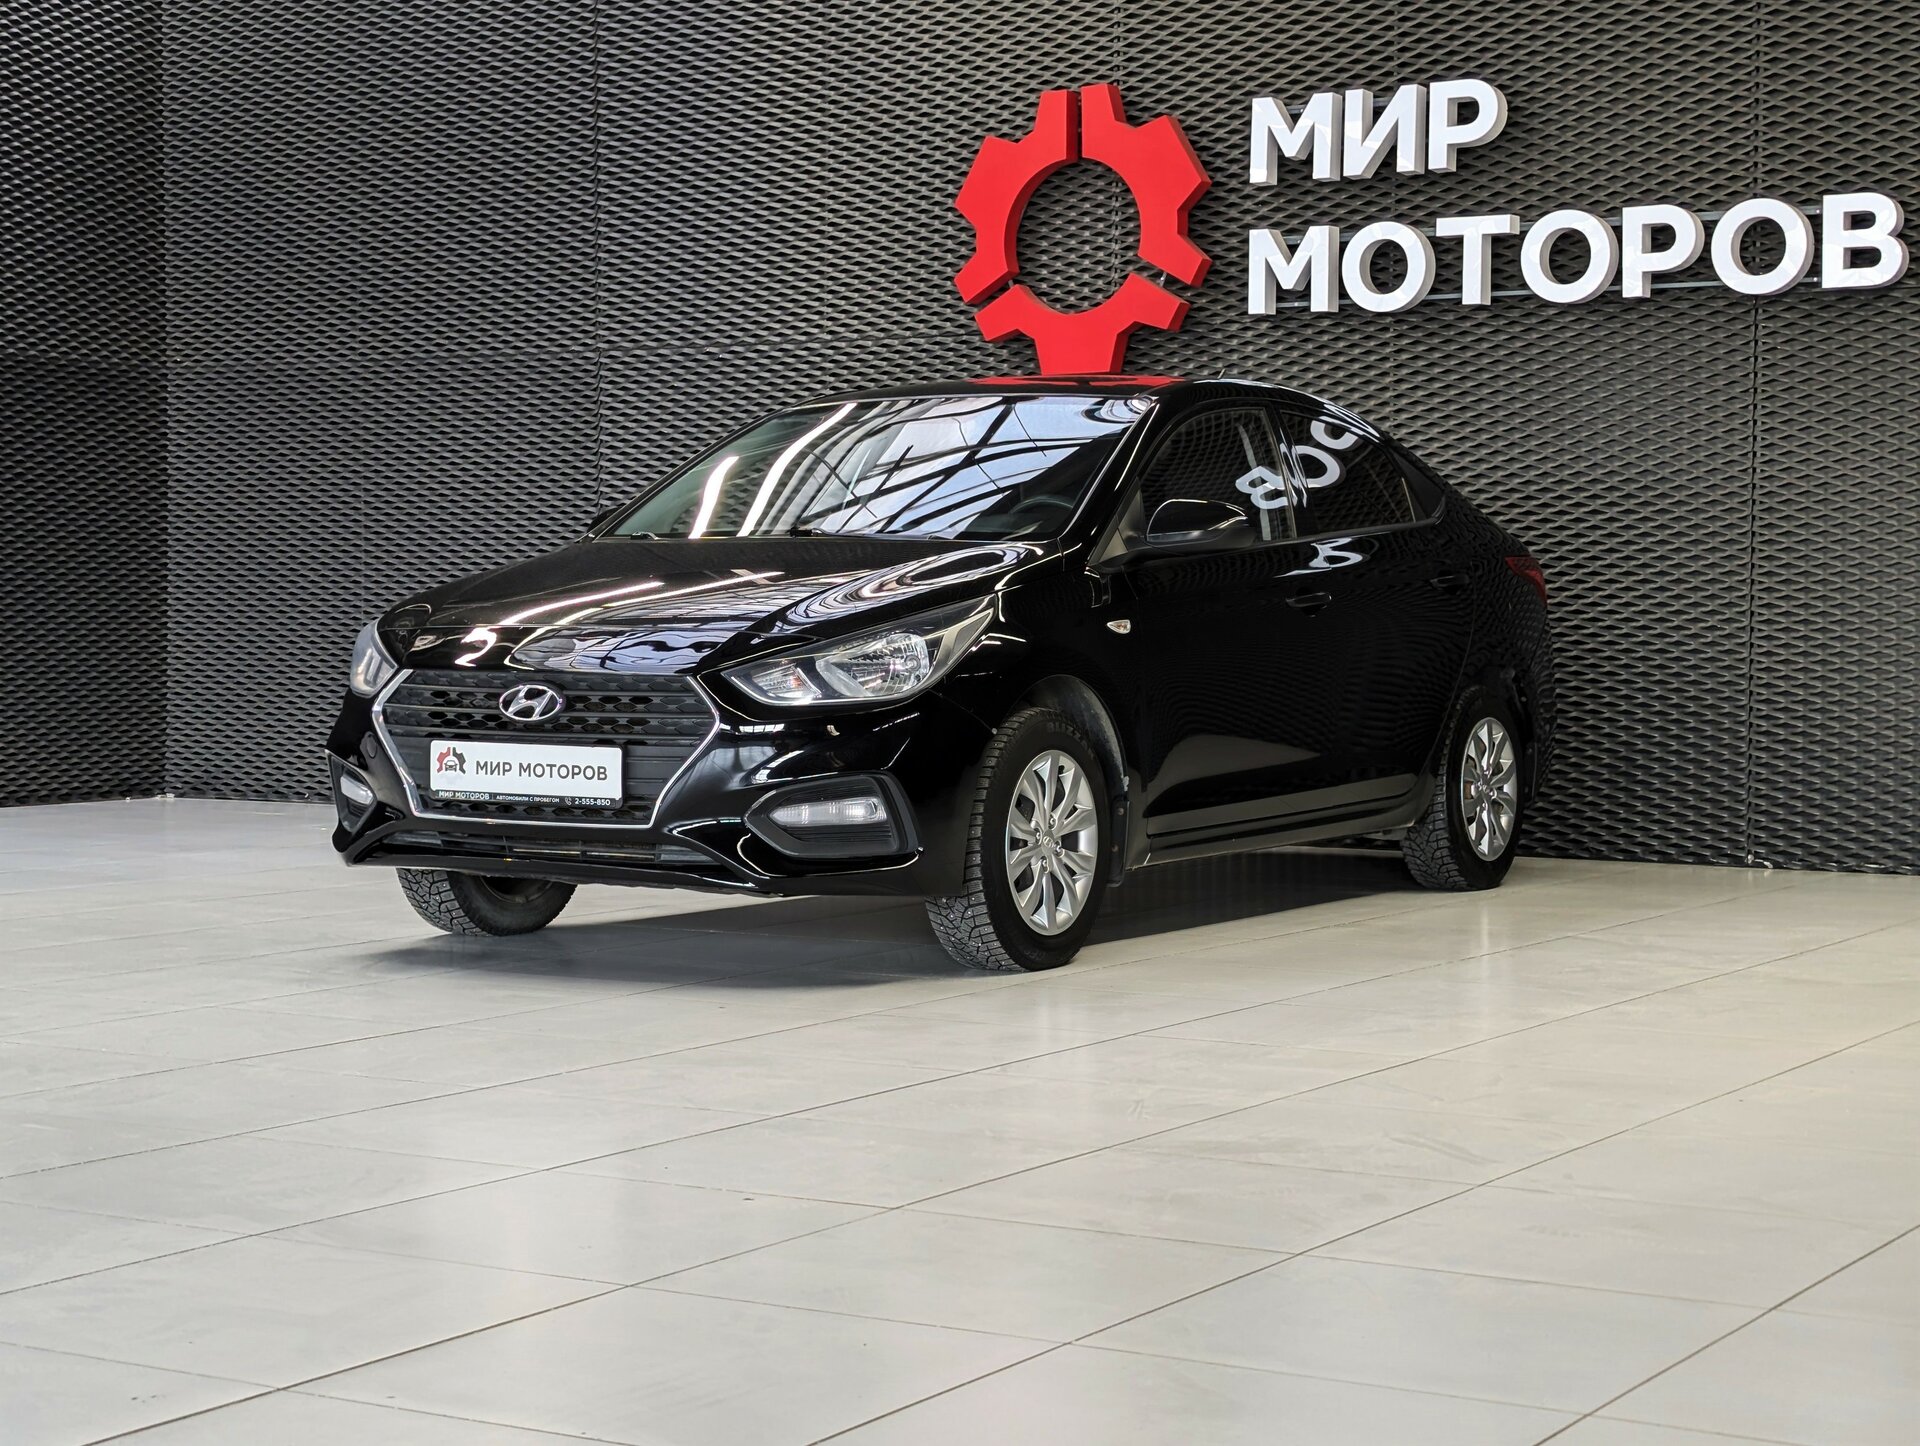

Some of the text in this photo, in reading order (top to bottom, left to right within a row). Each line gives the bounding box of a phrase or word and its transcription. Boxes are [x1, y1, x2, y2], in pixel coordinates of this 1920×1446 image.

[1249, 78, 1508, 186] МИР
[1247, 191, 1909, 315] МОТОРОВ
[475, 760, 608, 781] МИР МОТОРОВ
[438, 790, 490, 800] МИР МОТОРОВ
[574, 798, 611, 806] 2-555-850
